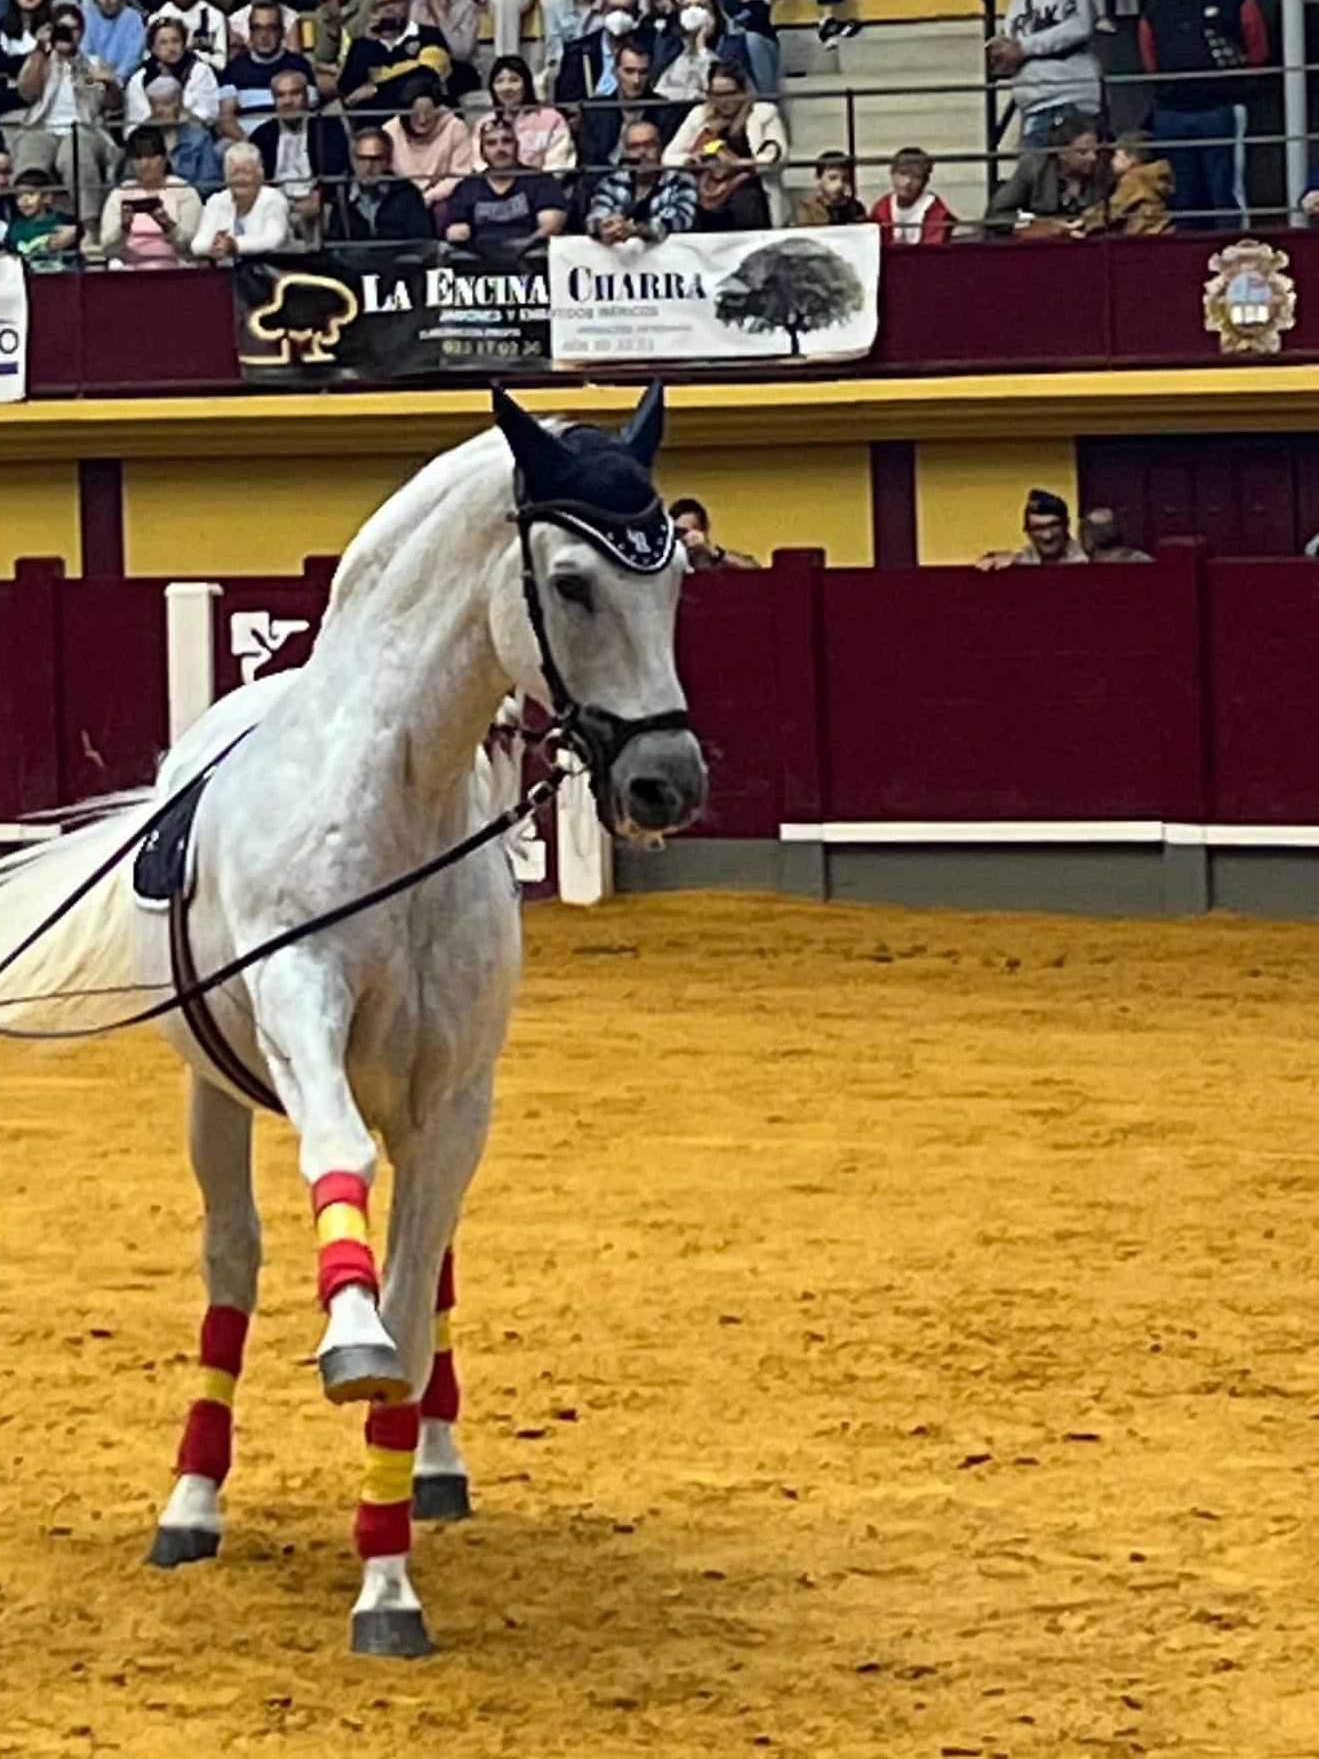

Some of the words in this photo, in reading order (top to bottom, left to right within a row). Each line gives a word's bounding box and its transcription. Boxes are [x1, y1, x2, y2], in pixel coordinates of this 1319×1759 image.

[360, 273, 414, 314] LA
[425, 267, 550, 307] ENCINA
[568, 265, 707, 303] CHARRA
